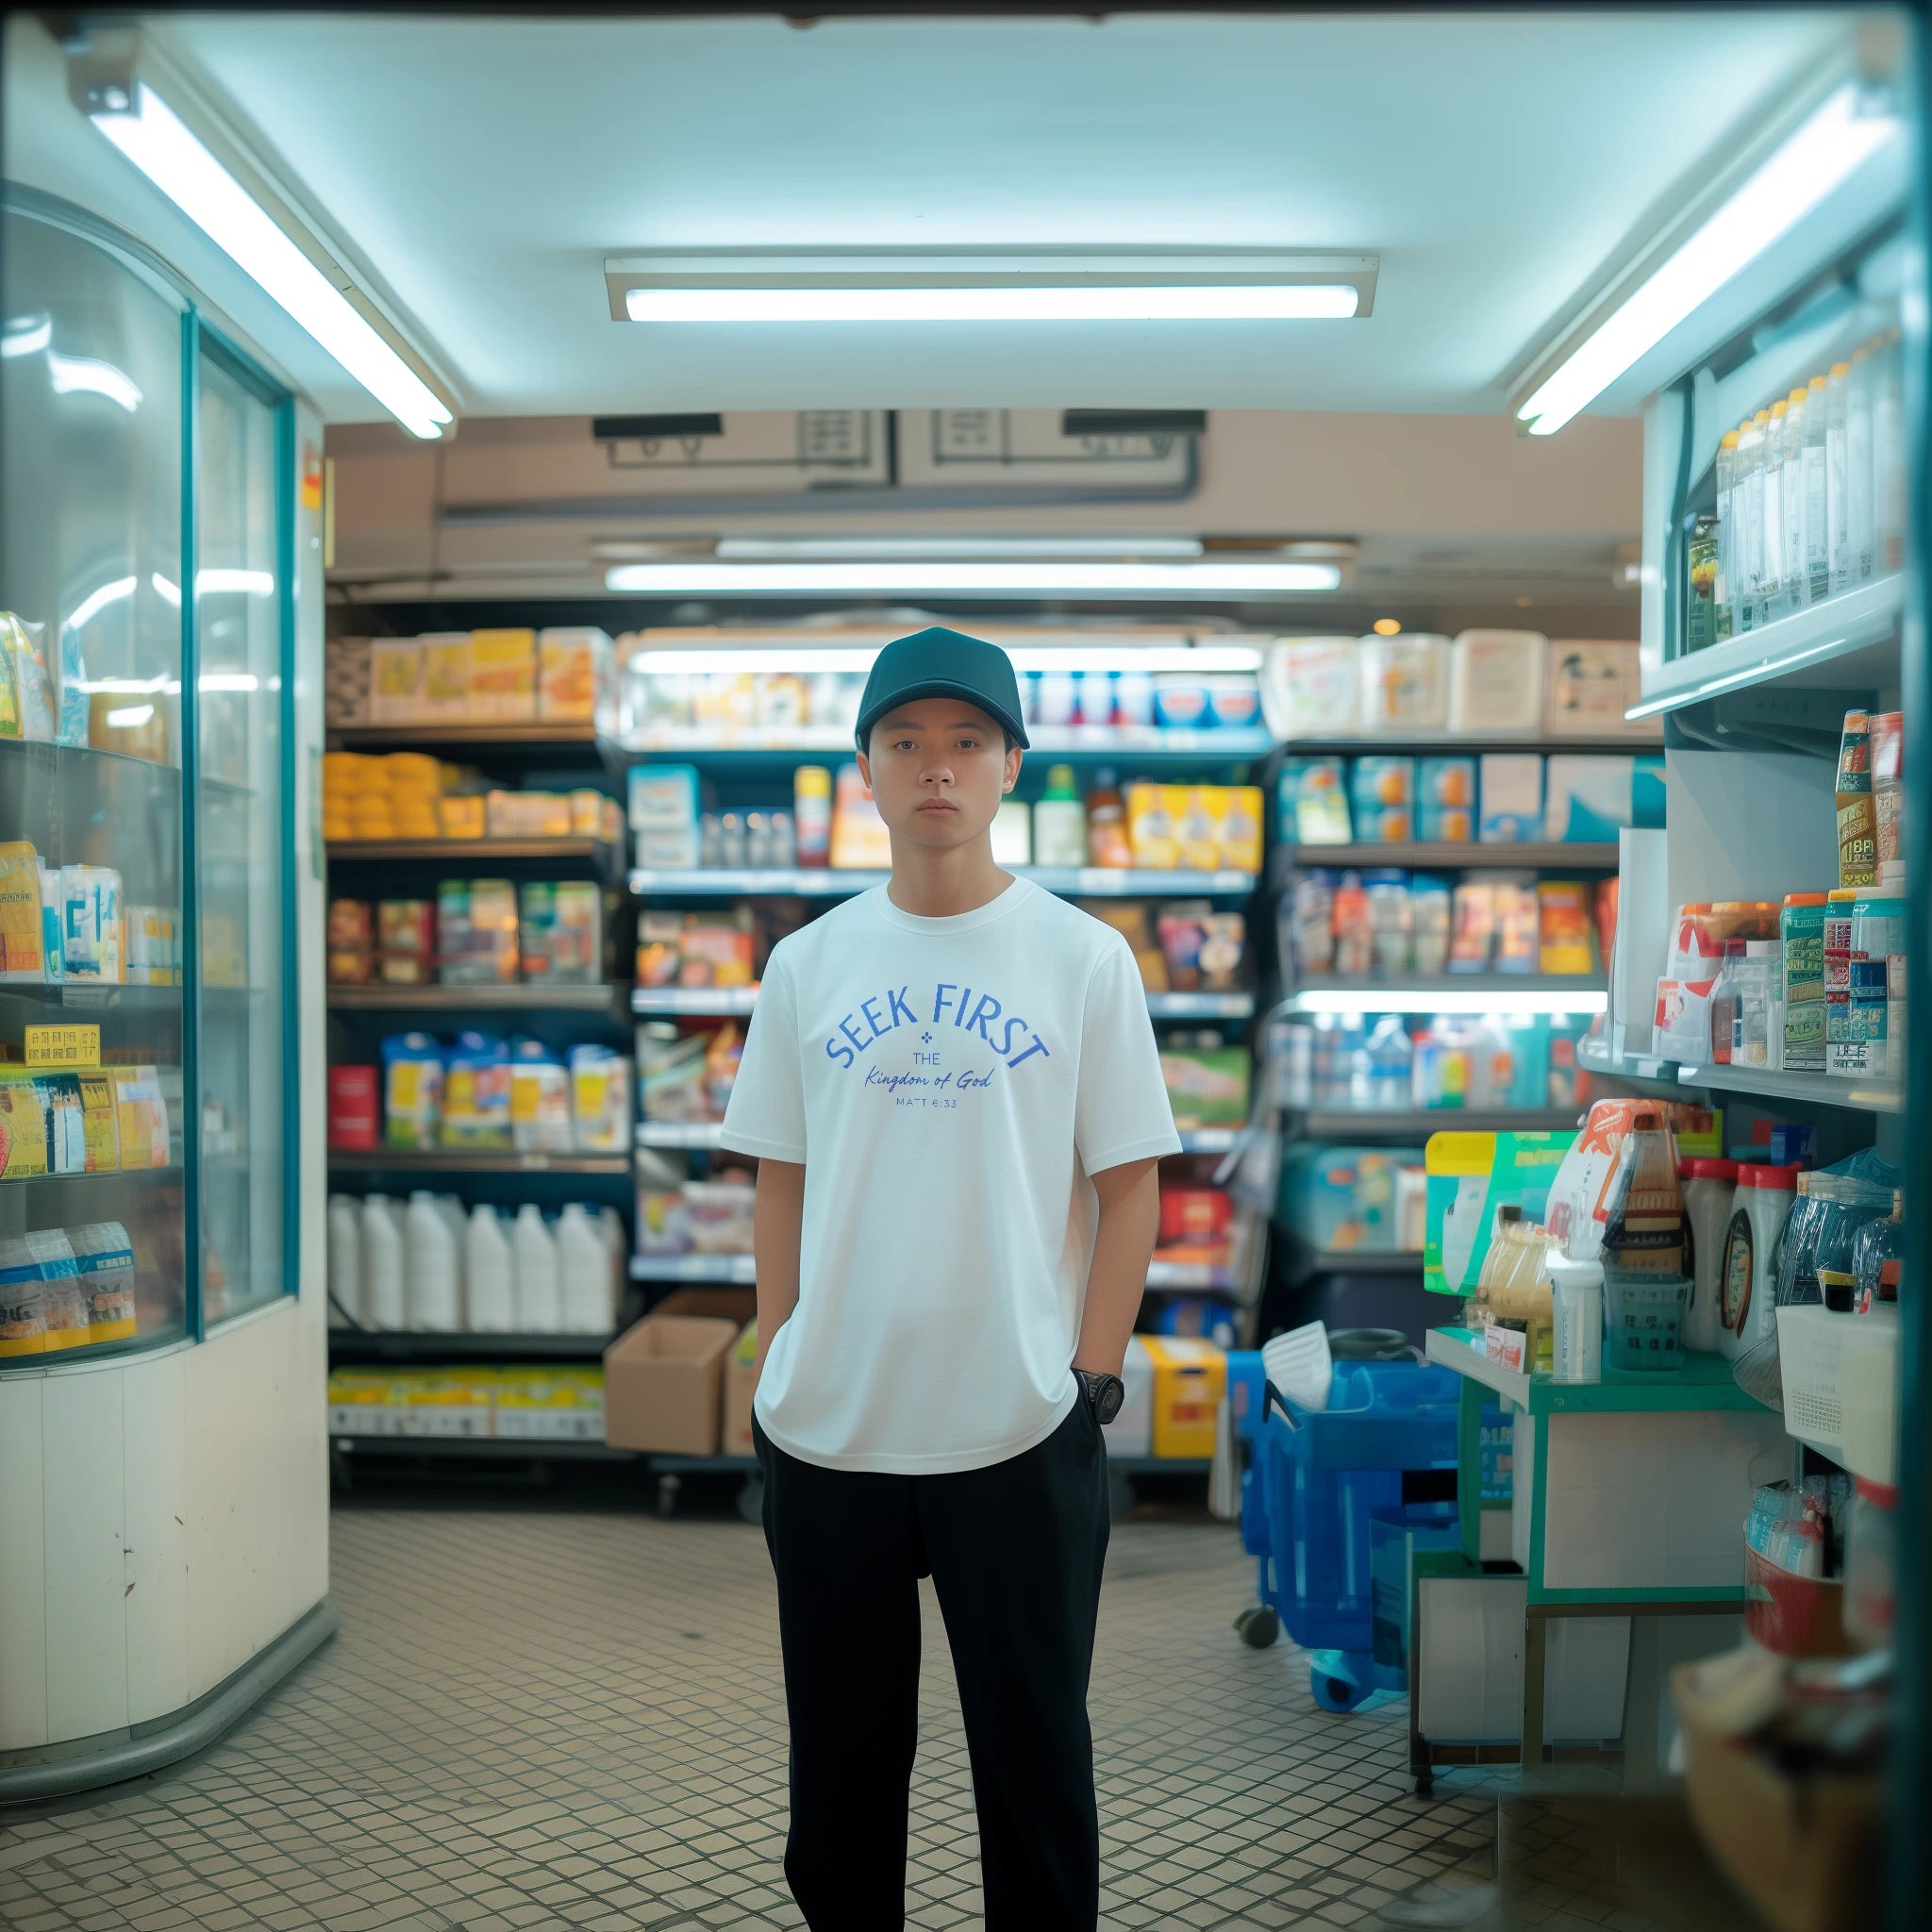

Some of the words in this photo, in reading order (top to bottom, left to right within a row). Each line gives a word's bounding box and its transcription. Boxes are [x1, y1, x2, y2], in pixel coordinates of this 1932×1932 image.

[826, 986, 918, 1069] SEEK
[933, 983, 1050, 1069] FIRST
[912, 1052, 941, 1065] THE
[864, 1065, 929, 1092] Kingdom
[934, 1072, 953, 1089] of
[957, 1068, 994, 1090] God
[896, 1097, 926, 1107] MATT
[932, 1099, 957, 1108] 6:33
